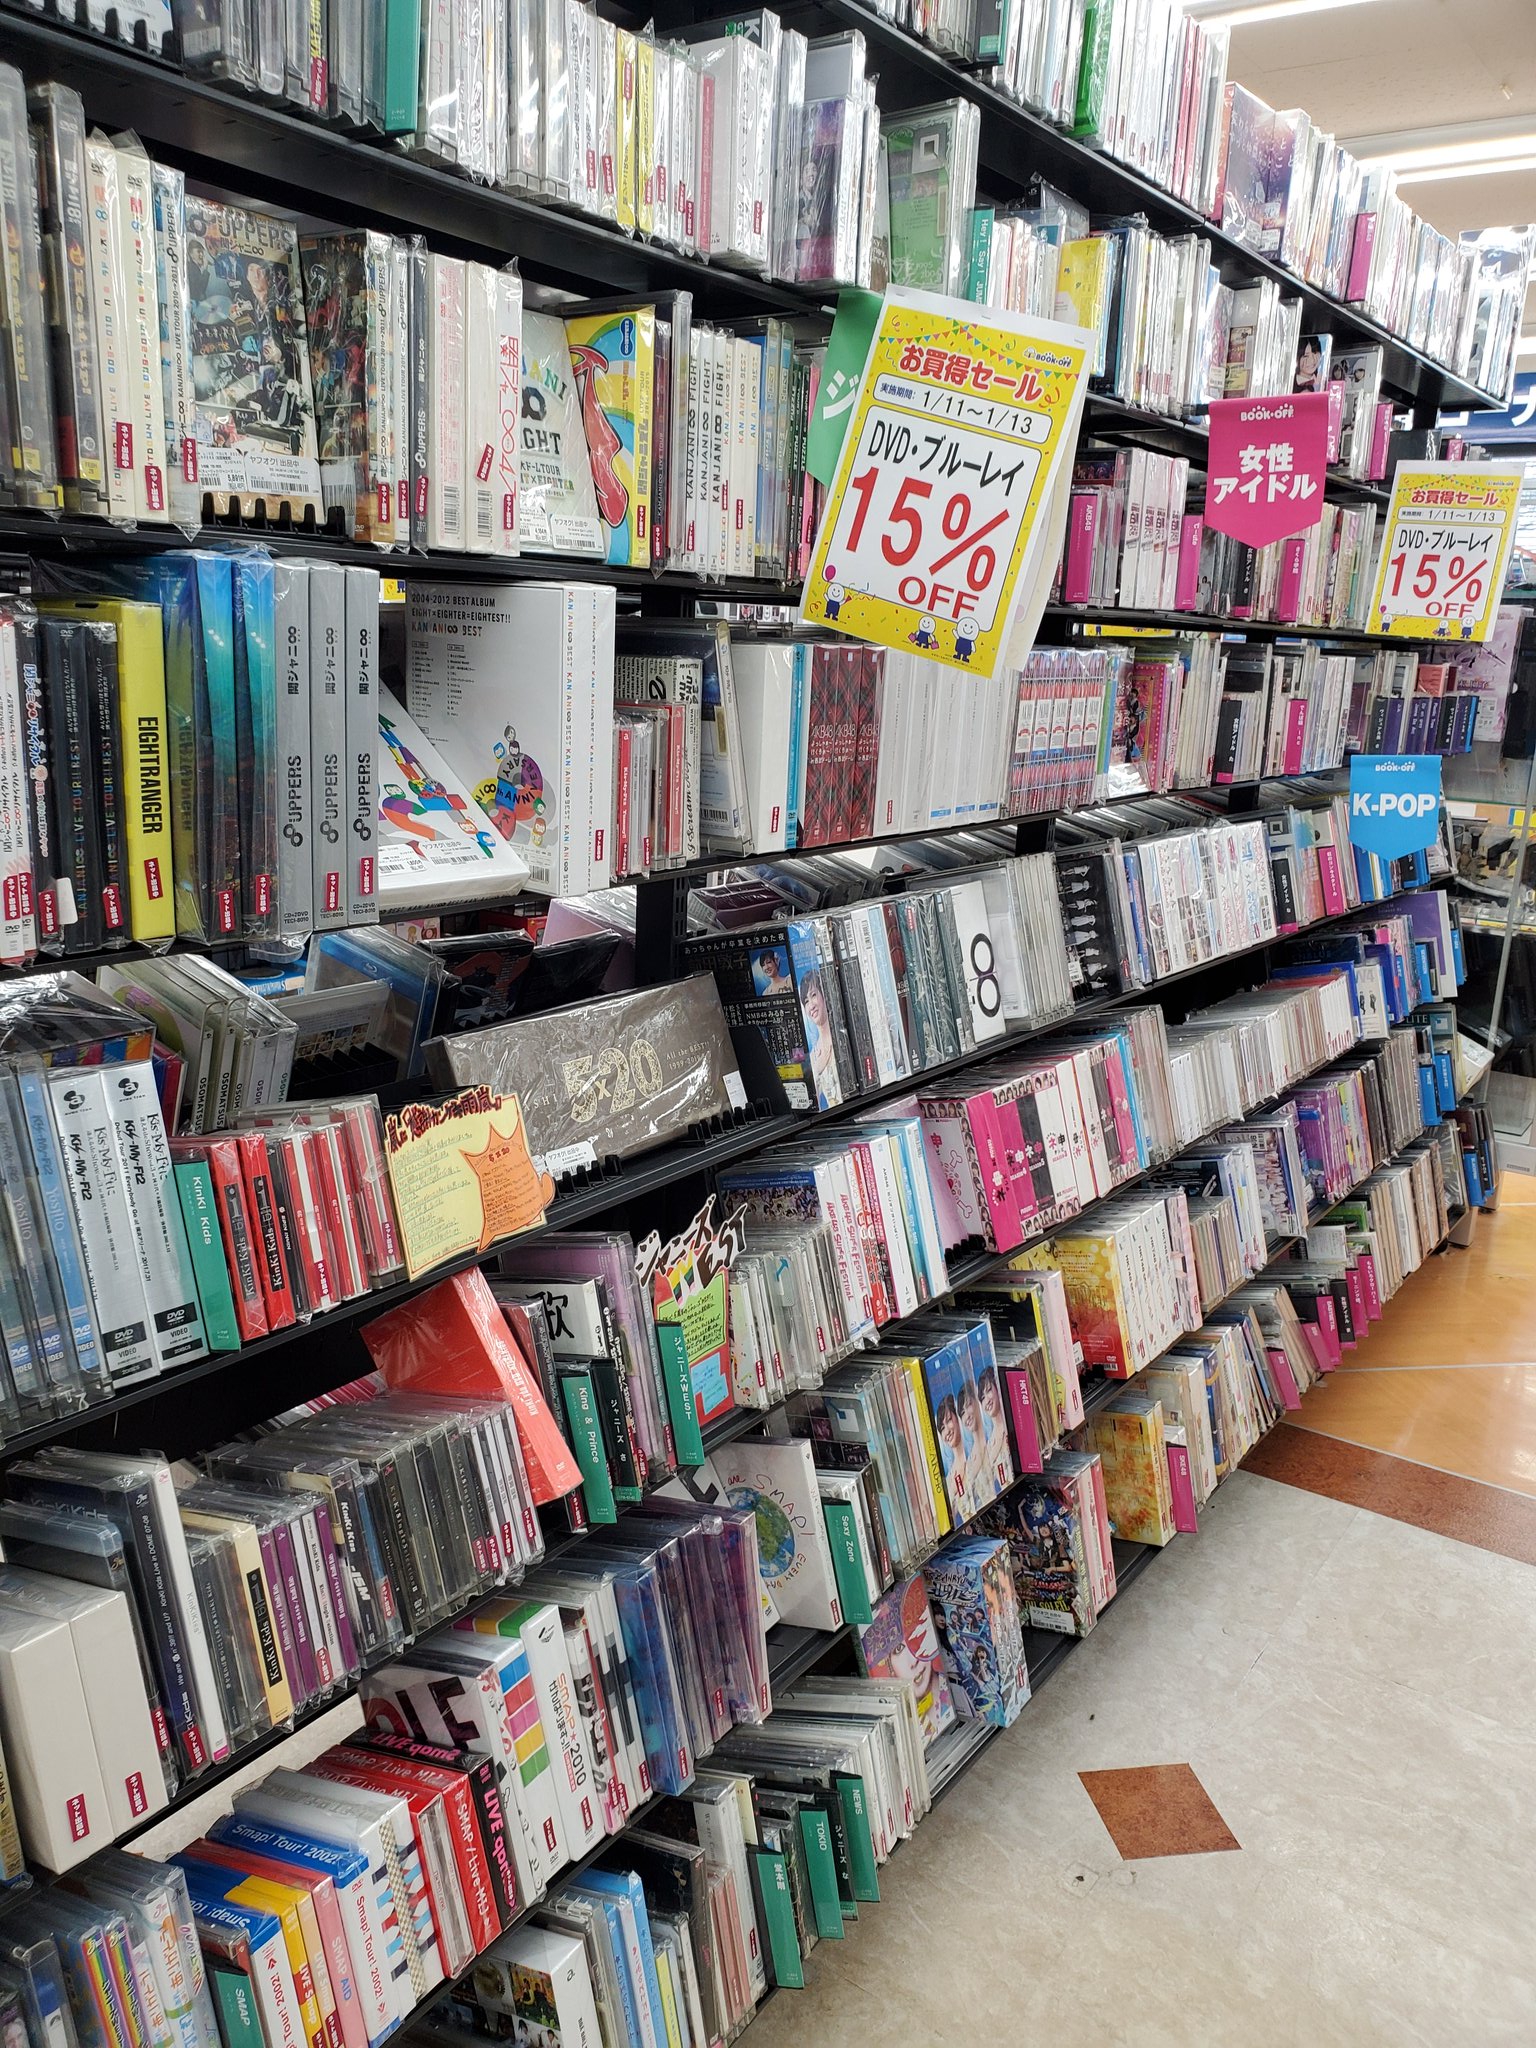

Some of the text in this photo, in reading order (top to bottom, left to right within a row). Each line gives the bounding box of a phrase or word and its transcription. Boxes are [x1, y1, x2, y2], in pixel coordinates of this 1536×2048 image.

[715, 362, 724, 407] FIGHT
[899, 344, 1043, 402] お買得セール
[867, 420, 1025, 497] DVD・ブルーレイ
[1238, 442, 1295, 474] 女性
[1213, 474, 1318, 505] アイドル
[1410, 489, 1499, 506] お買得セール
[845, 466, 1011, 591] 15%
[1085, 505, 1094, 531] AKB48
[1398, 530, 1494, 553] DVD・ブルーレイ
[1391, 552, 1488, 602] 15%
[452, 596, 470, 606] BEST
[470, 597, 496, 607] ALBUM
[898, 576, 980, 619] OFF
[1425, 602, 1475, 618] OFF
[287, 626, 300, 694] 関ジャニ∞
[325, 627, 337, 694] 関ジャニ∞
[359, 628, 371, 694] 関ジャニ∞
[811, 724, 834, 738] AKB48
[835, 724, 857, 737] AKB48
[860, 723, 880, 737] AKB48
[138, 716, 163, 834] EIGHTRANGER
[105, 811, 117, 838] LIVE
[1352, 793, 1436, 818] K-POP
[74, 815, 85, 842] LIVE
[684, 933, 785, 955] あっちゃんが卒業を決めた夜
[124, 1169, 133, 1203] Everybody
[193, 1176, 212, 1246] KinKi Kids
[265, 1227, 284, 1288] KinKi Kids
[170, 1326, 189, 1338] VIDEO
[674, 1336, 692, 1421] ジャニーズWEST
[1019, 1379, 1029, 1405] HKT48
[579, 1387, 590, 1410] King
[587, 1430, 599, 1463] Prince
[610, 1399, 625, 1443] ジャニーズ
[1179, 1455, 1187, 1476] SKE48
[841, 1516, 856, 1563] Sexy Zone
[263, 1619, 280, 1681] KinKi Kids
[557, 1672, 587, 1787] SMAP 2010
[384, 1760, 411, 1777] Live
[484, 1787, 504, 1834] LIVE
[852, 1789, 863, 1815] NEWS
[231, 1824, 342, 1865] Smap! Tour! 2002!
[457, 1802, 481, 1887] SMAP Live
[816, 1821, 828, 1851] TOKIO
[835, 1825, 847, 1864] ジャニーズ
[773, 1863, 786, 1891] 堂本剛
[356, 1895, 383, 1999] Smap! Tour! 2002!
[331, 1936, 353, 2001] SMAP AID
[235, 1988, 251, 2026] SMAP
